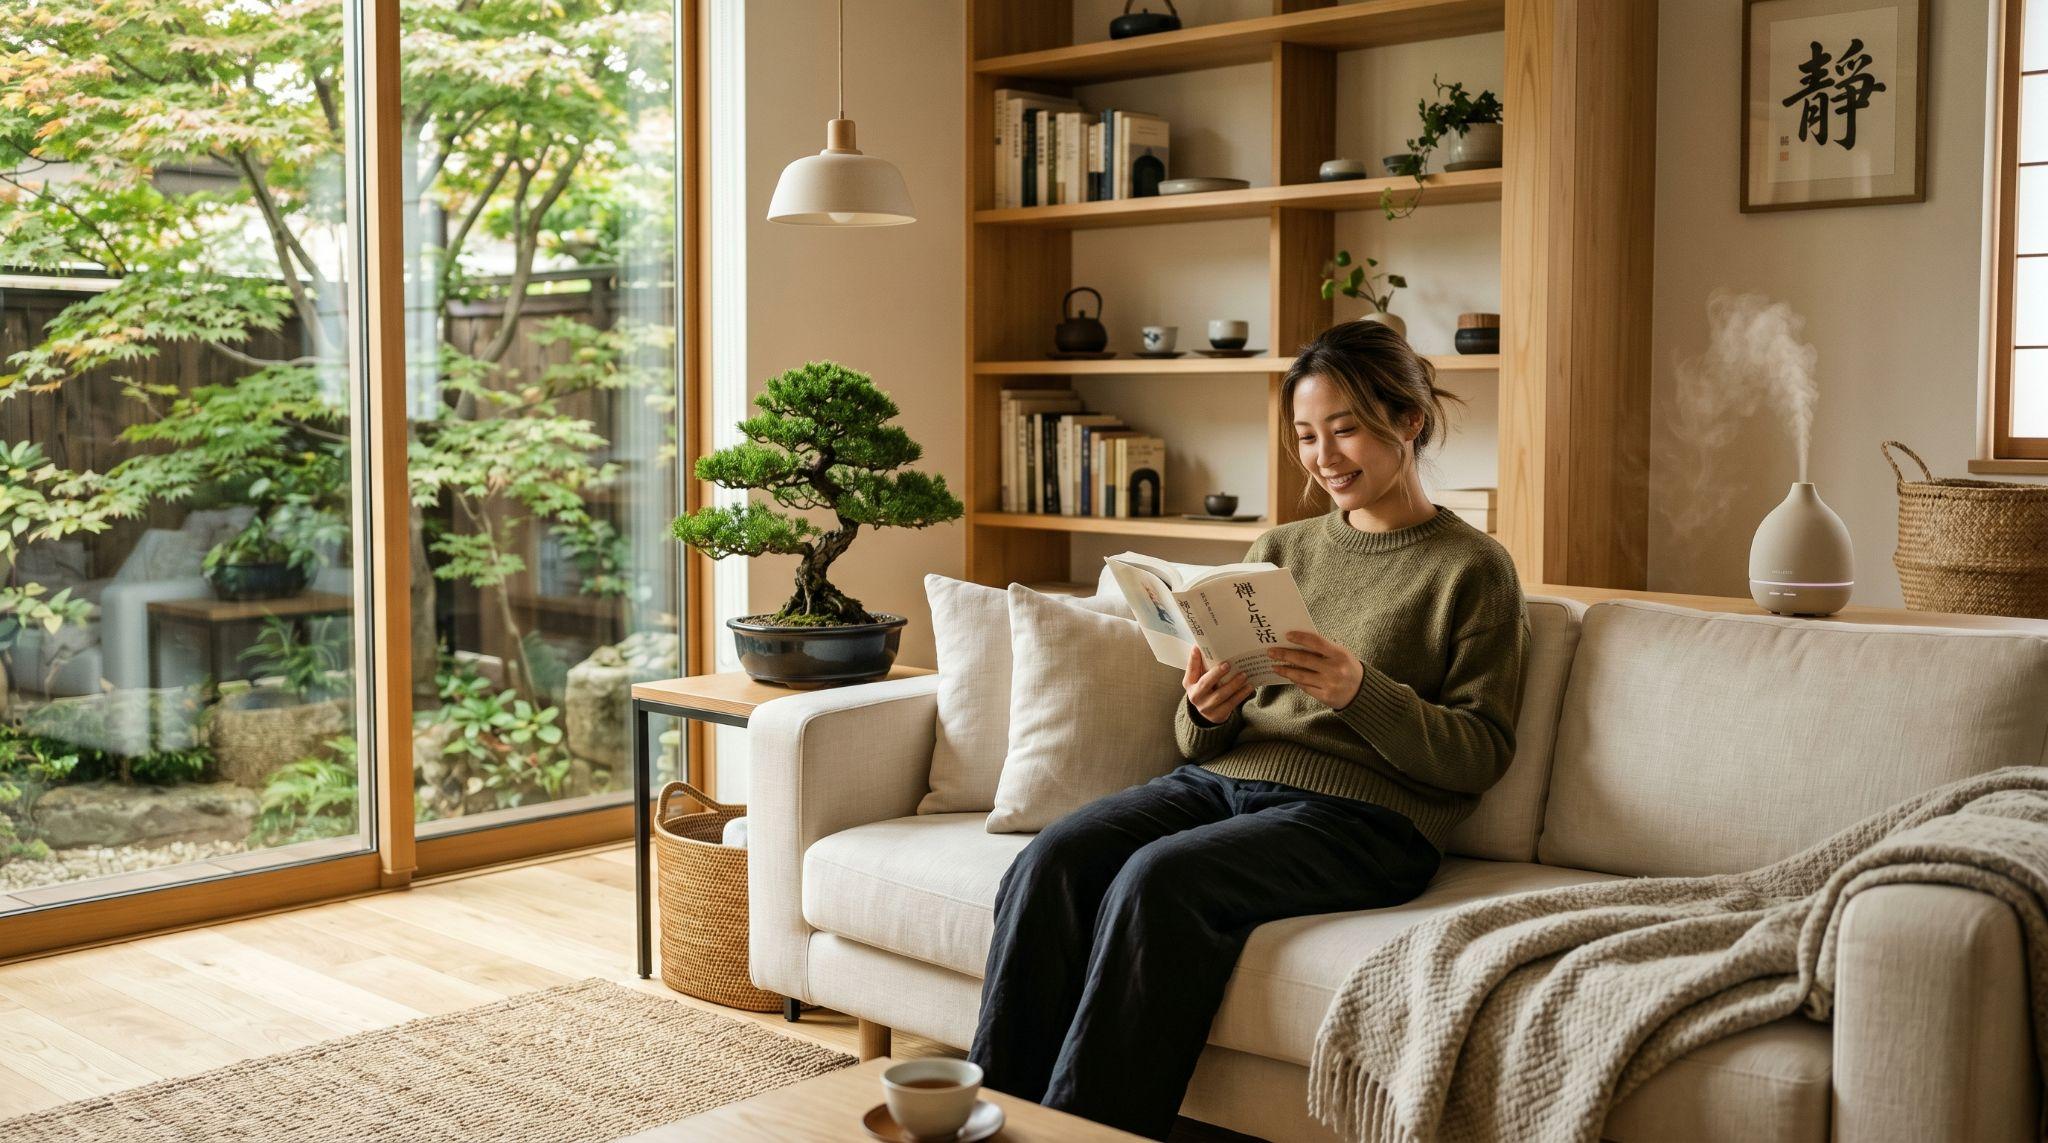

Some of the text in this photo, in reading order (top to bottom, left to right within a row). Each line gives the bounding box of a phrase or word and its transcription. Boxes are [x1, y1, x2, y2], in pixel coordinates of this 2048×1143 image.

[1782, 38, 1886, 150] 靜
[1233, 582, 1278, 644] 禅と生活
